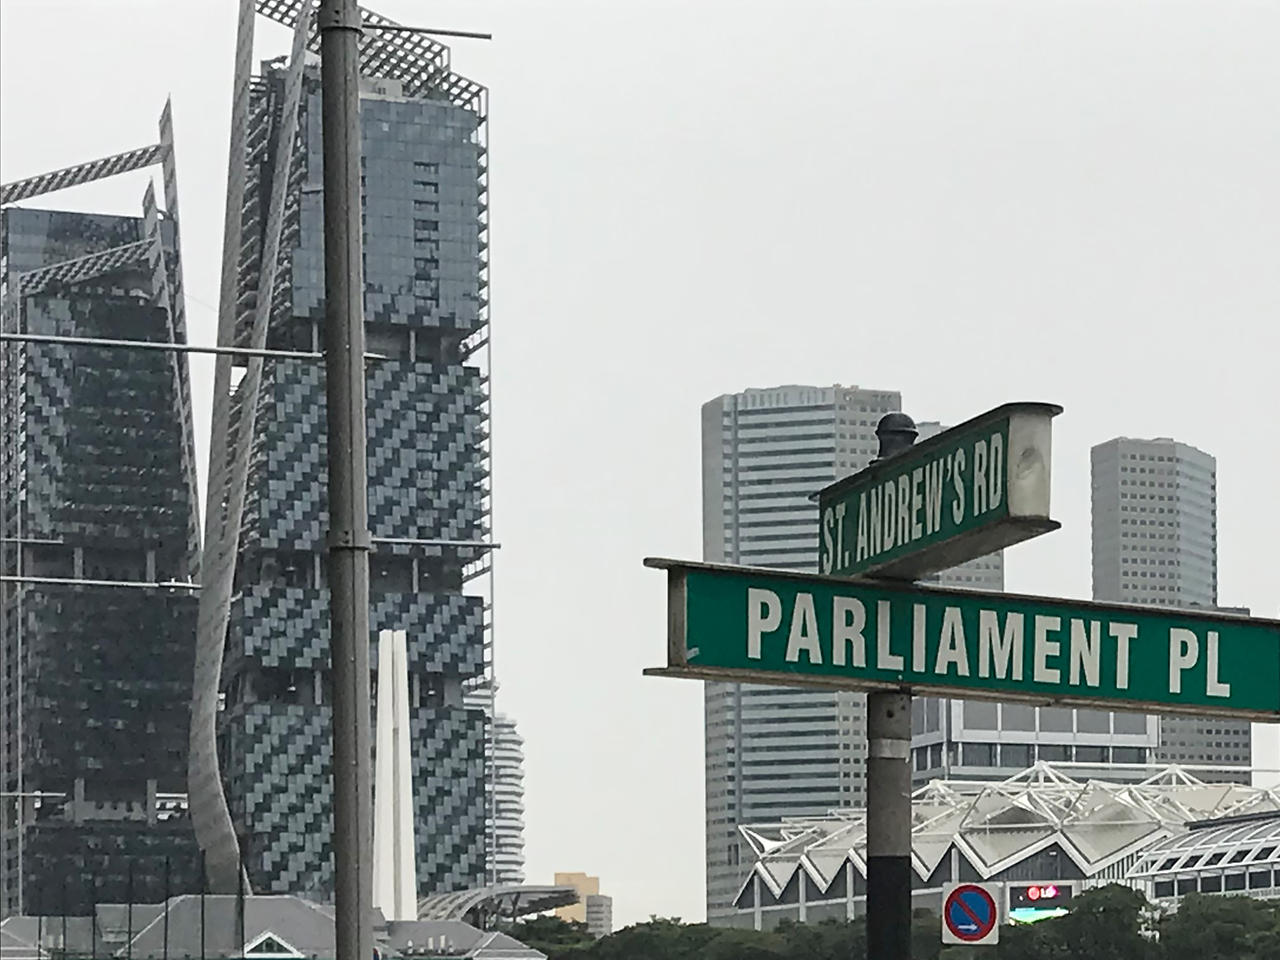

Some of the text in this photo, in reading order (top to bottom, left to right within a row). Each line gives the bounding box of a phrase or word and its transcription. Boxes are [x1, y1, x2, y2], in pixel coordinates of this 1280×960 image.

[823, 432, 1003, 575] ST. ANDREW'S RD
[747, 588, 1231, 698] PARLIAMENT PL
